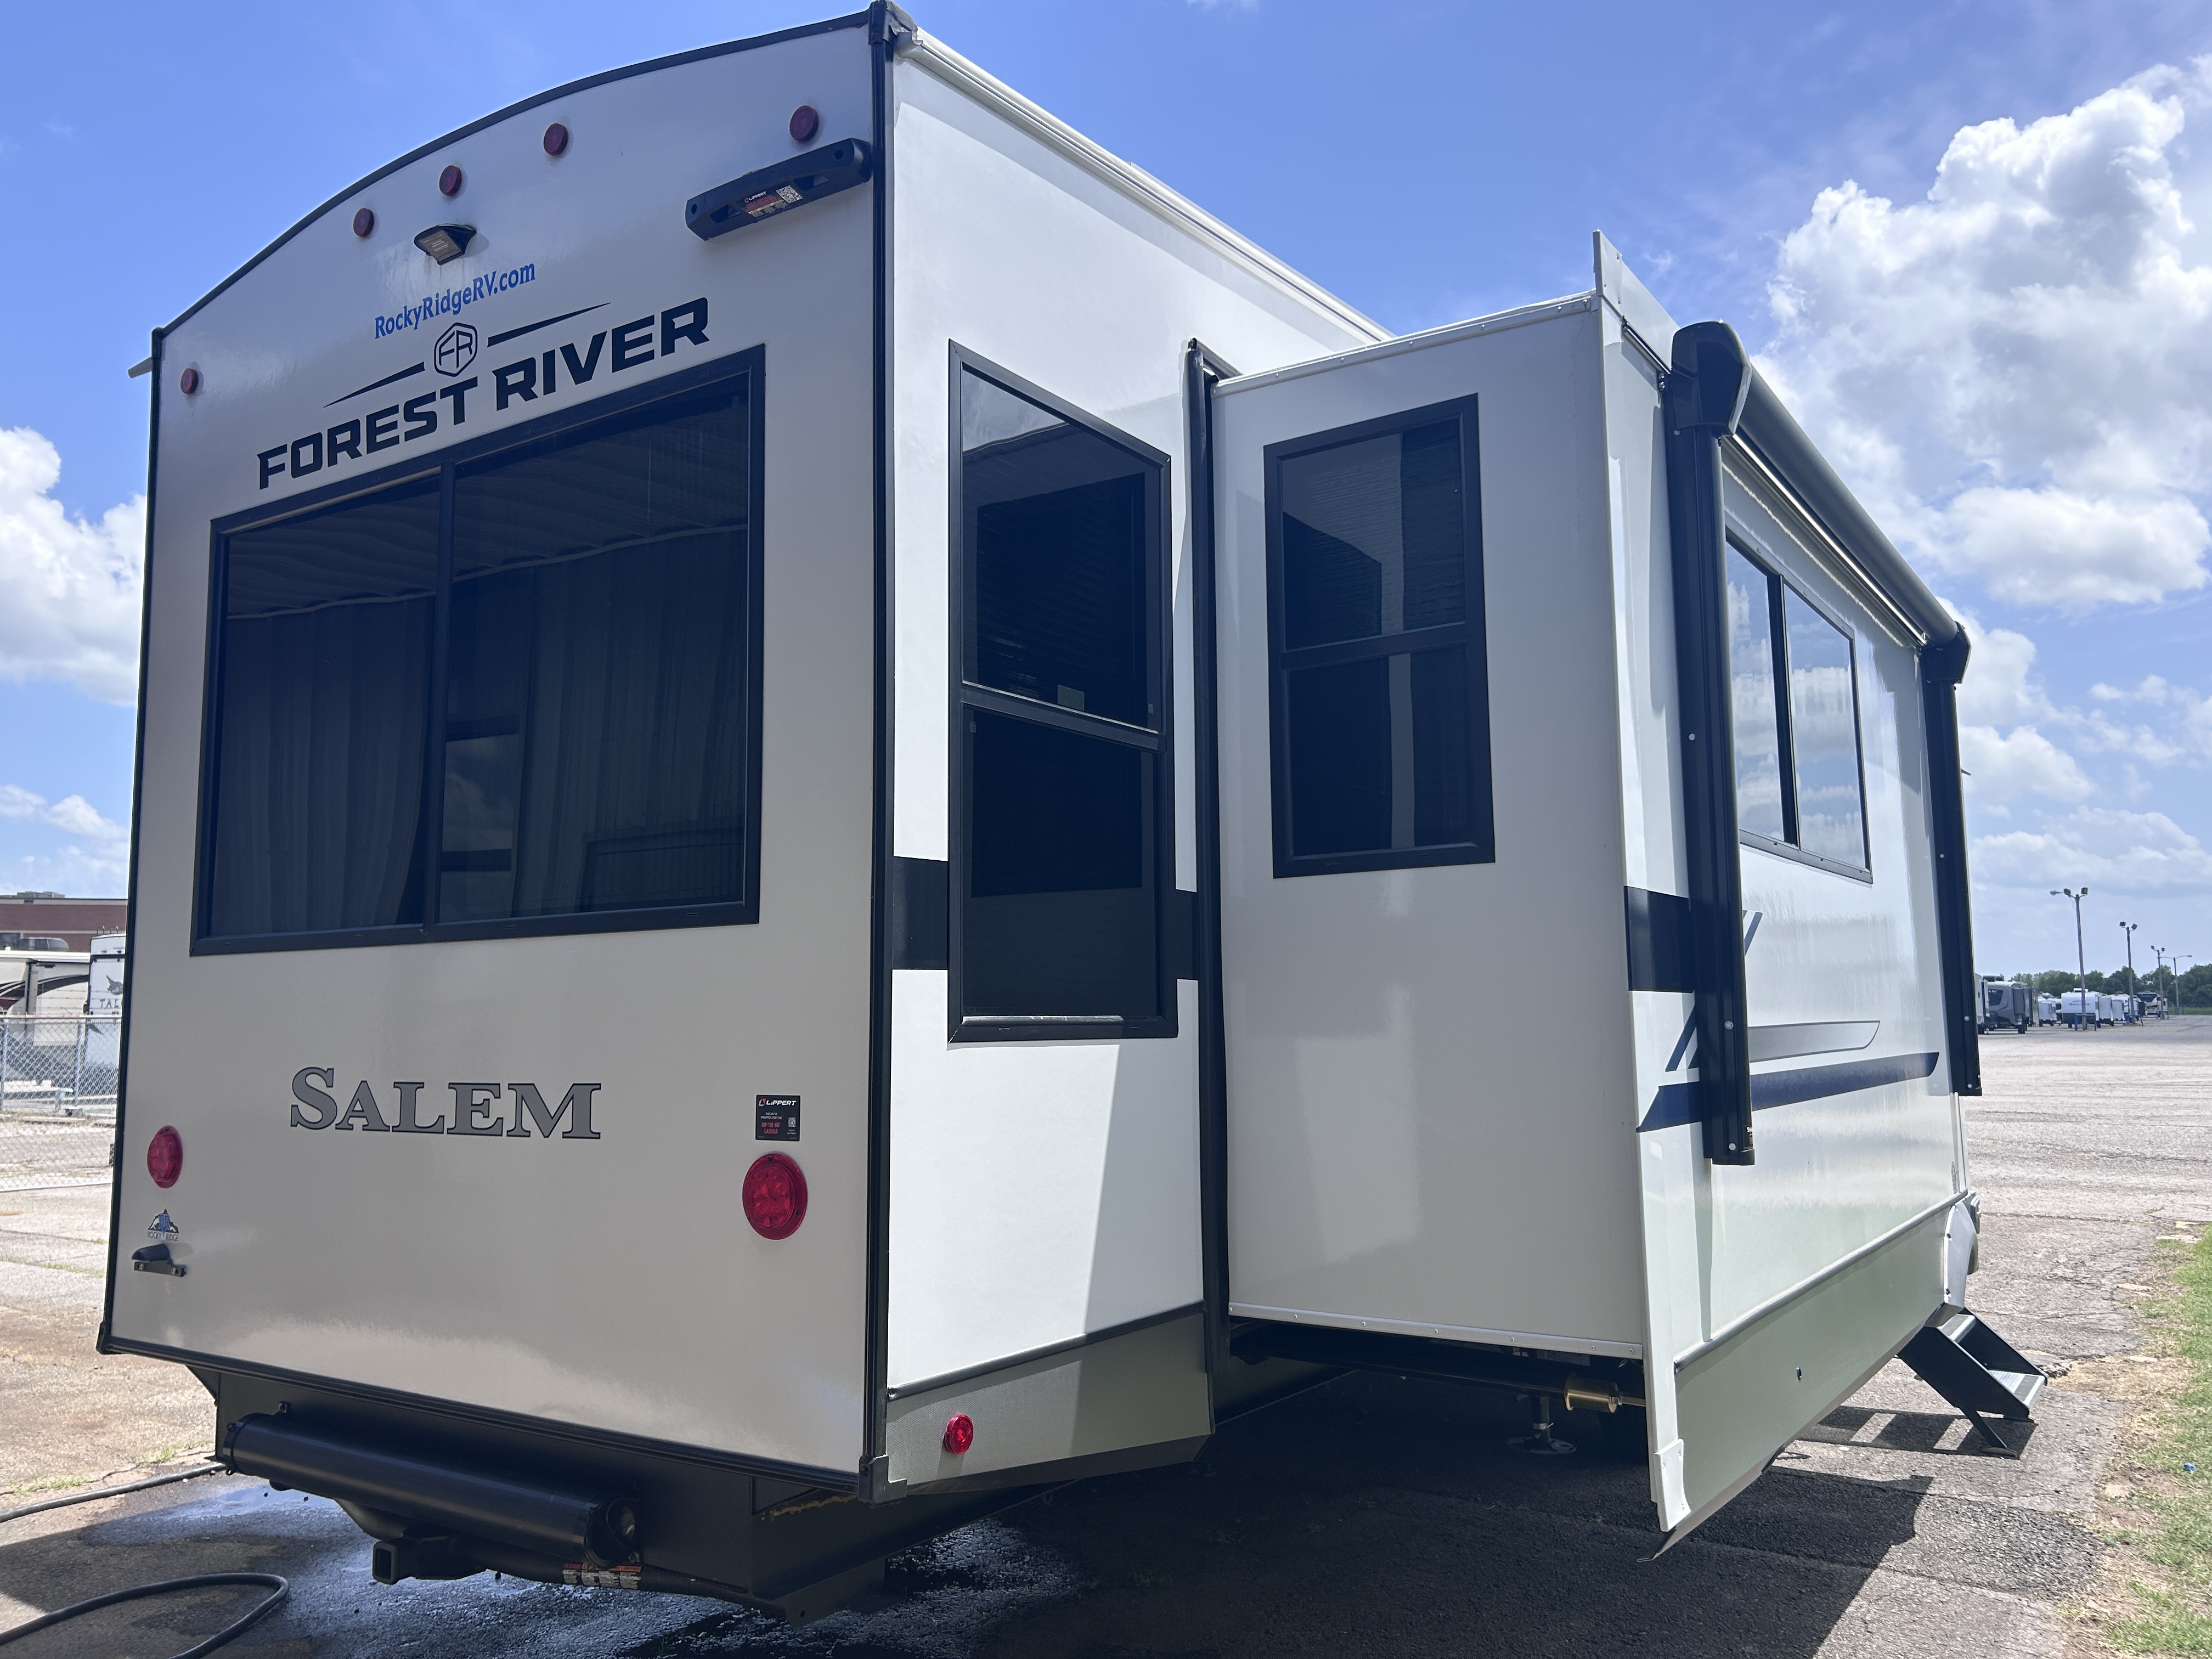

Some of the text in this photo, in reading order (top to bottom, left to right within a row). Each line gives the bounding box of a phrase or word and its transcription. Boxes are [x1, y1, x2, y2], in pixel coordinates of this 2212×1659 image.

[375, 263, 535, 339] RockyRidgeRV.com
[257, 297, 710, 490] FOREST RIVER
[99, 998, 122, 1009] TAL
[290, 1066, 601, 1139] SALEM
[147, 1231, 179, 1242] ROCKY RIDGE
